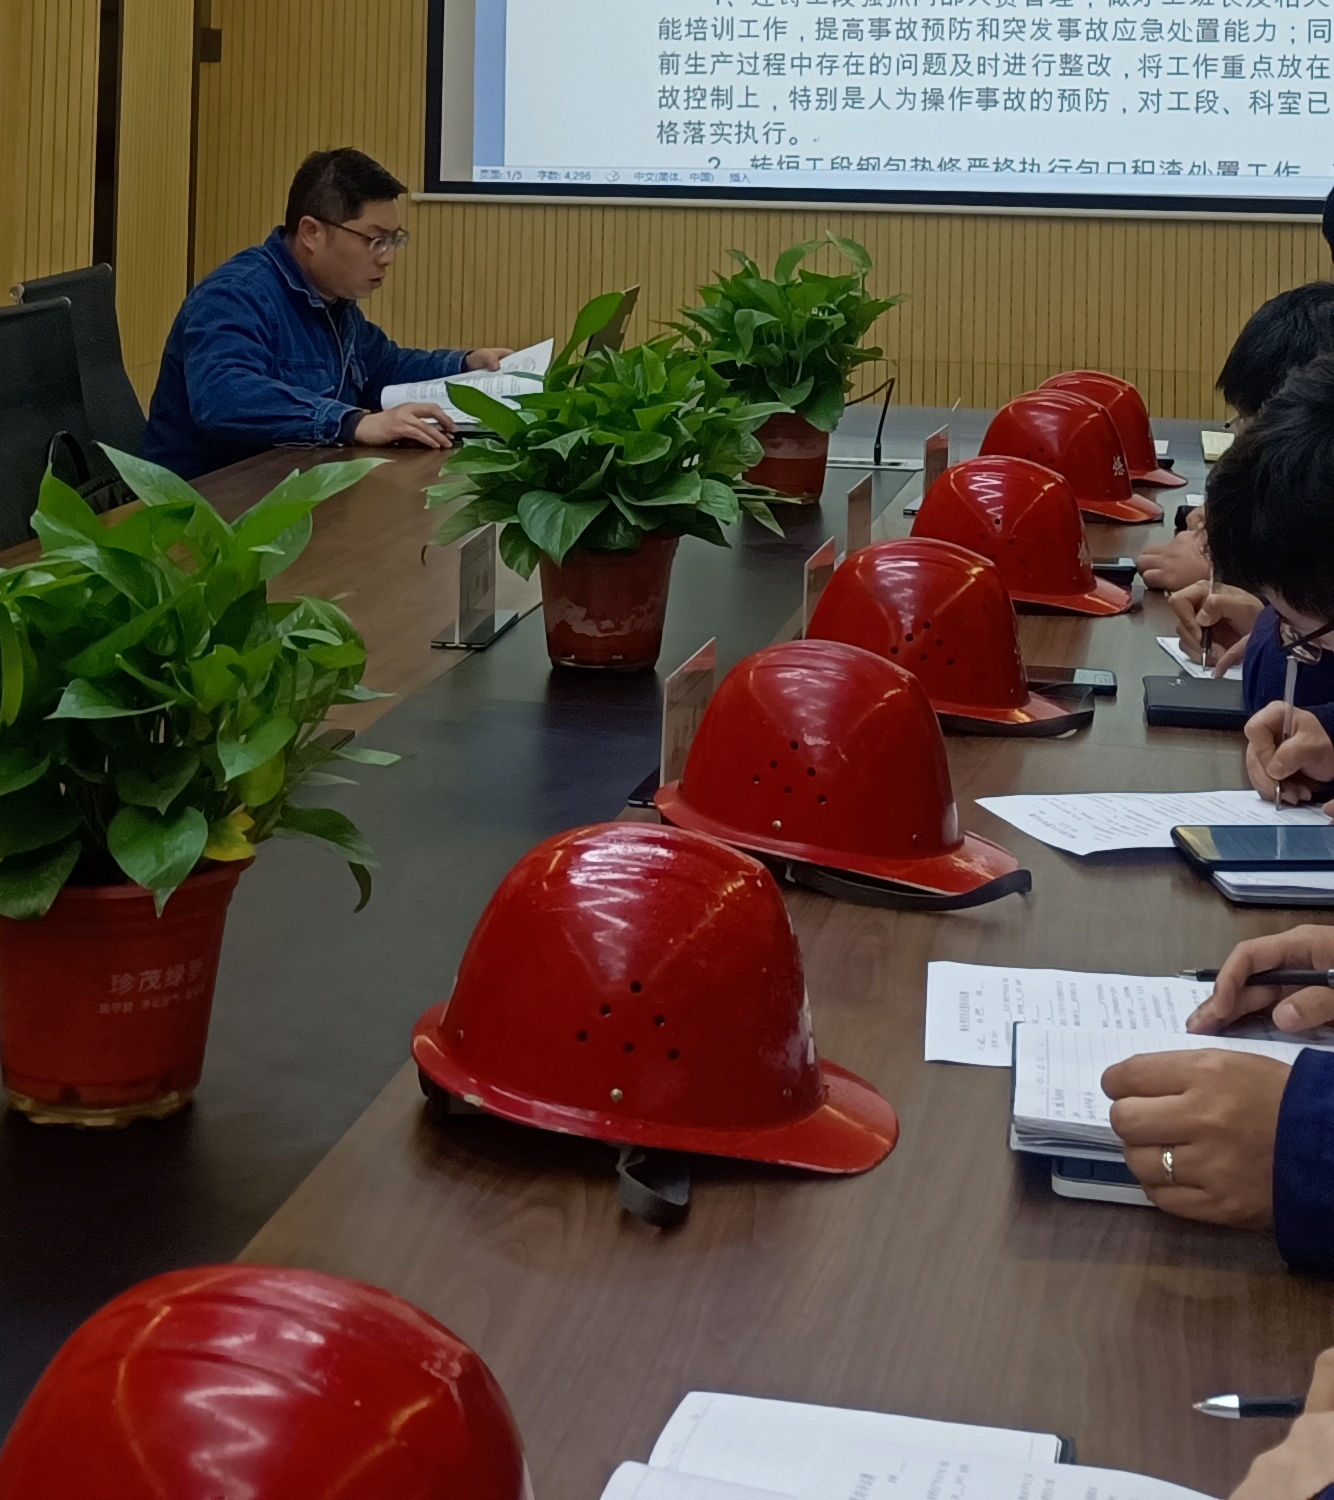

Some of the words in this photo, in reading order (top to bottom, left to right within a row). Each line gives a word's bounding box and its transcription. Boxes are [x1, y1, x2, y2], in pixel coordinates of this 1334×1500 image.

[657, 120, 800, 146] 格落实执行。
